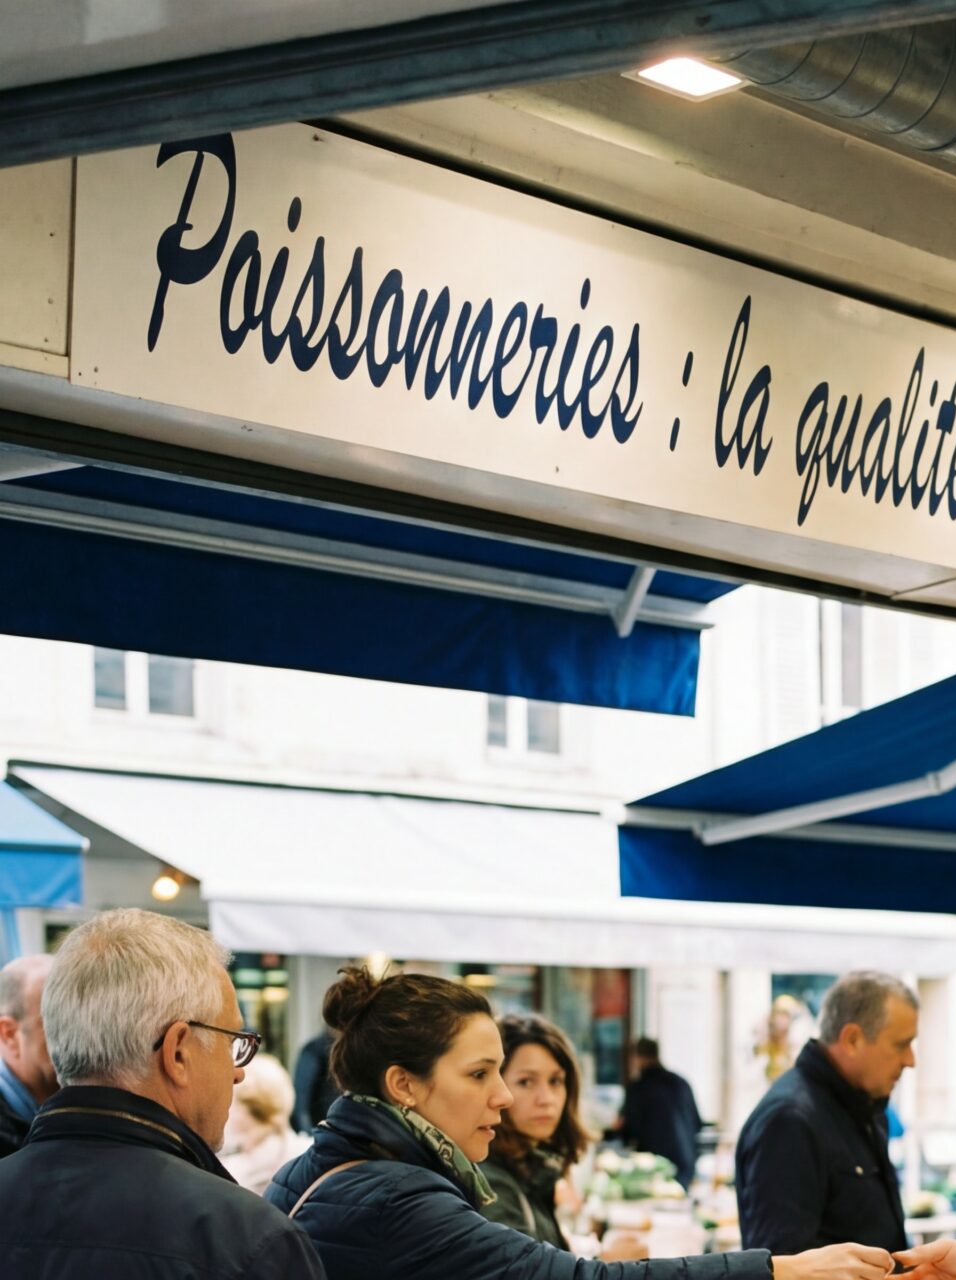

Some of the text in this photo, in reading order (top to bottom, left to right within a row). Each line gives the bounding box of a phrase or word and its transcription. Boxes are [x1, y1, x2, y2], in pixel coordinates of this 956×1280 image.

[147, 132, 644, 444] Poissonneries
[669, 350, 695, 453] :
[714, 294, 774, 477] la
